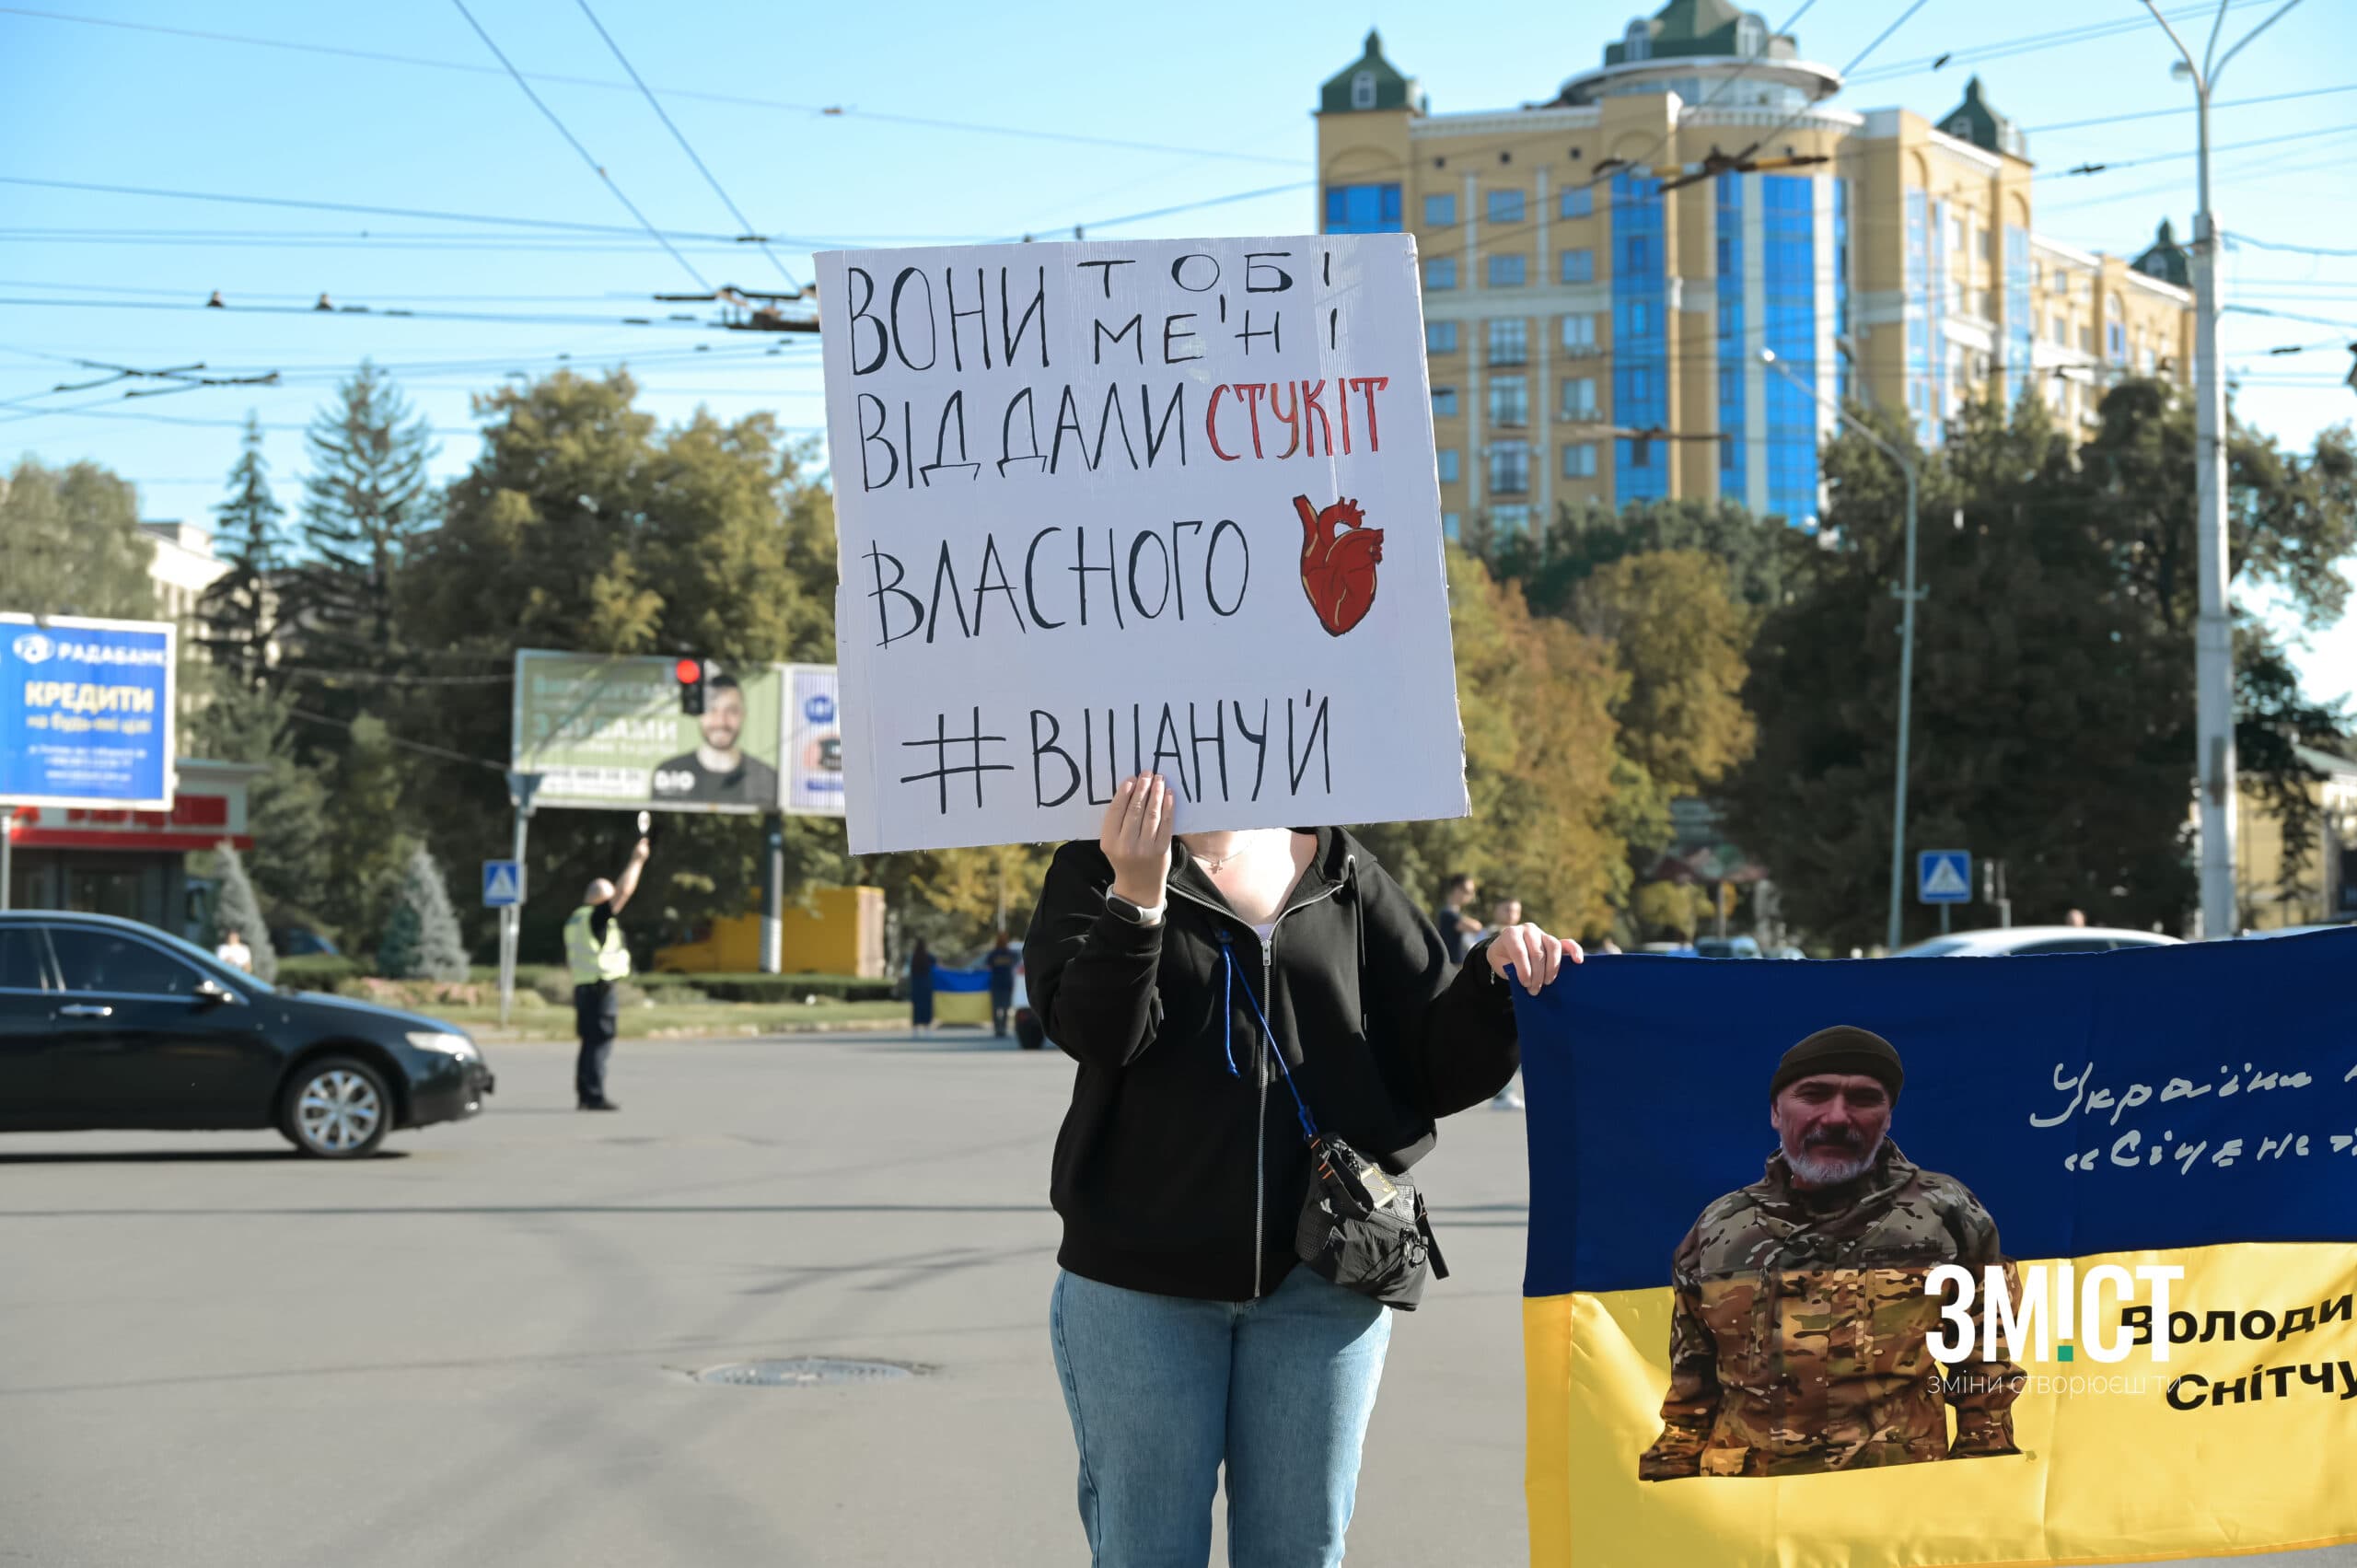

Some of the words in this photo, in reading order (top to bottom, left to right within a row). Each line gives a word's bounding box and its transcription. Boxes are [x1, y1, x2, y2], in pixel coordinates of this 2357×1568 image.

[848, 264, 1051, 377] ВОНИ
[1076, 250, 1332, 300] ТОБІ
[1204, 376, 1389, 462] СТУКІТ
[860, 518, 1250, 650] ВЛАСНОГО
[25, 681, 154, 714] КРЕДИТИ
[900, 688, 1331, 815] #ВШАНУЙ
[2029, 1061, 2313, 1128] Україна
